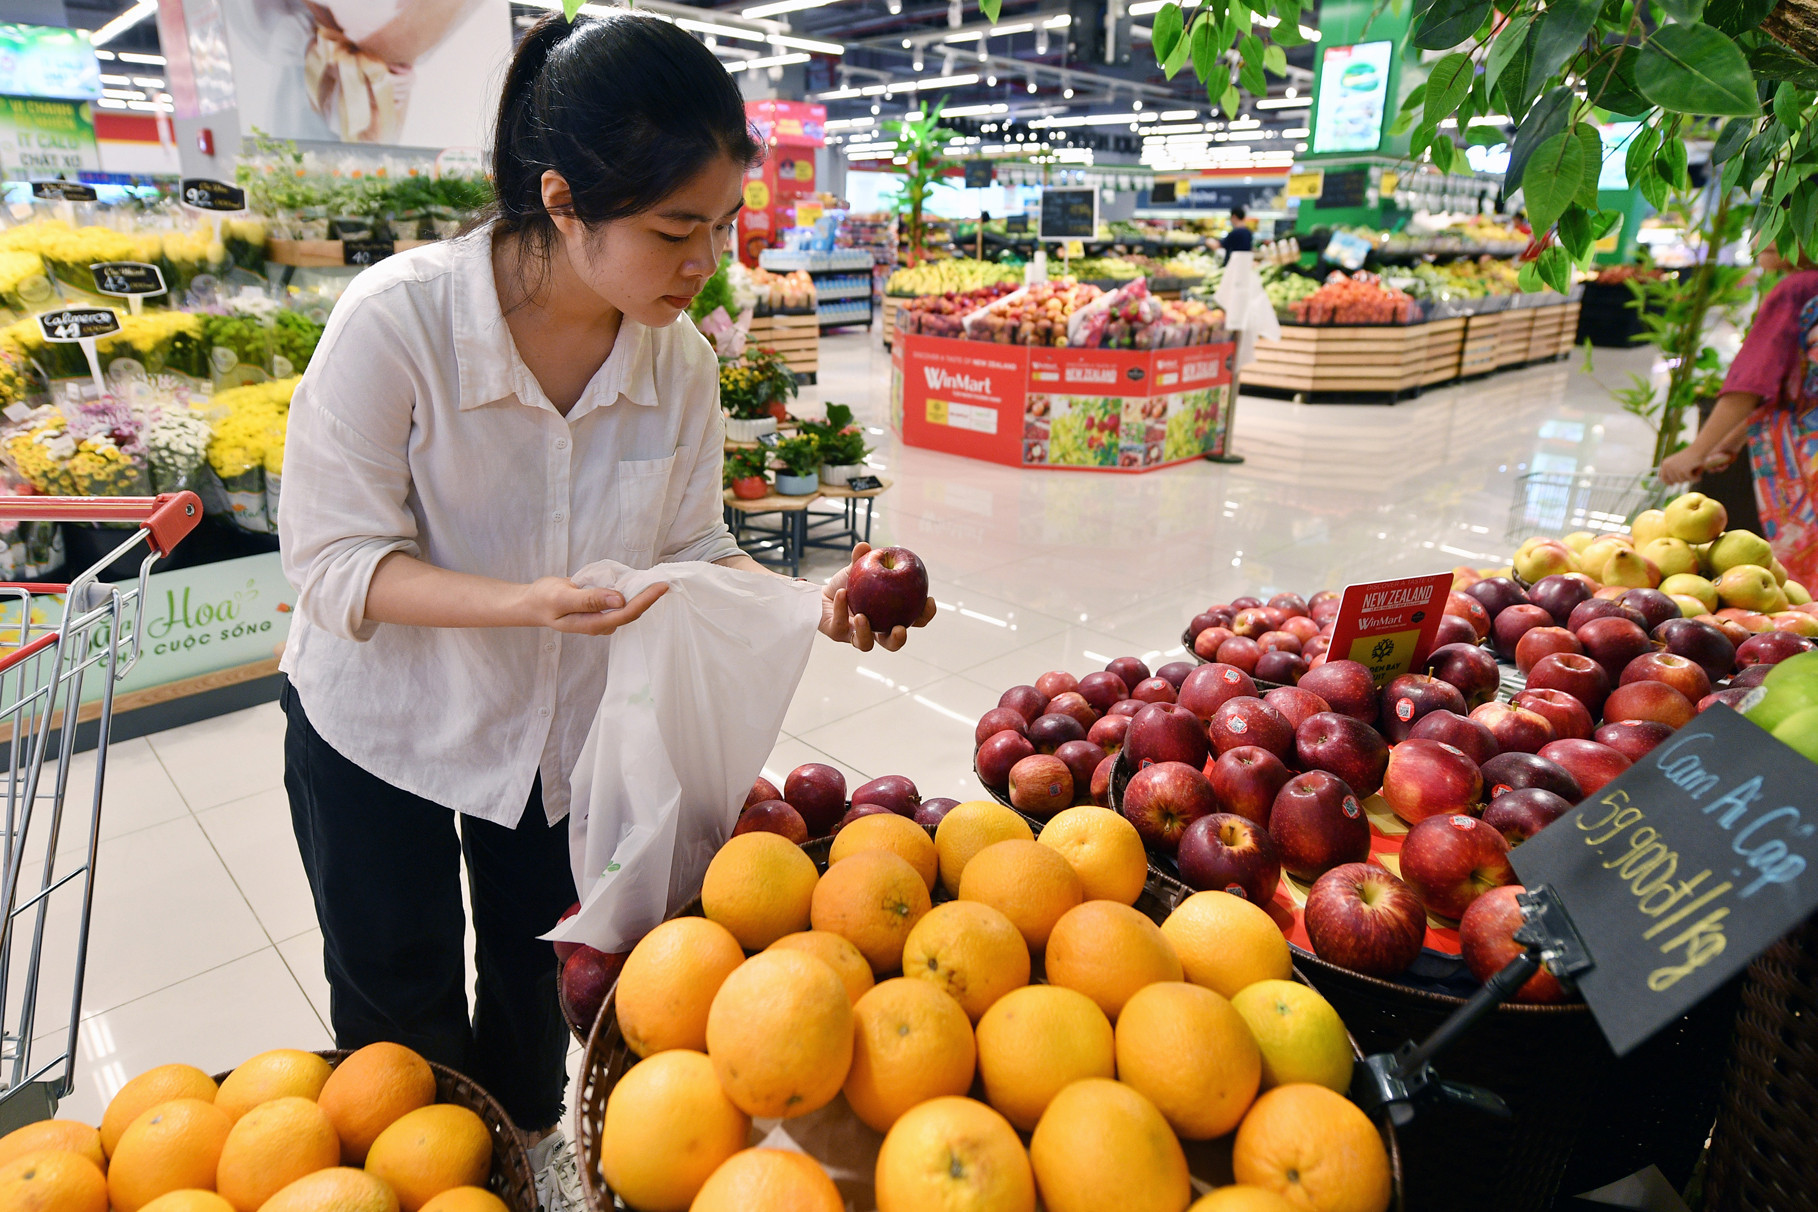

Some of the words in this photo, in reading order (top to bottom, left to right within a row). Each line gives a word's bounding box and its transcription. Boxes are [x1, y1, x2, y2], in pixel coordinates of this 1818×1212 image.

[186, 187, 214, 207] 92
[923, 365, 991, 395] WinMart
[1363, 590, 1389, 609] NEW
[1387, 585, 1434, 605] ZEALAND
[1367, 580, 1400, 591] DISCOVER
[147, 586, 236, 639] Hoa
[1358, 613, 1403, 631] WinMart
[154, 634, 211, 656] CUỘC
[221, 621, 273, 641] SỐNG
[1386, 662, 1402, 671] BAY
[1657, 732, 1720, 800] Cam
